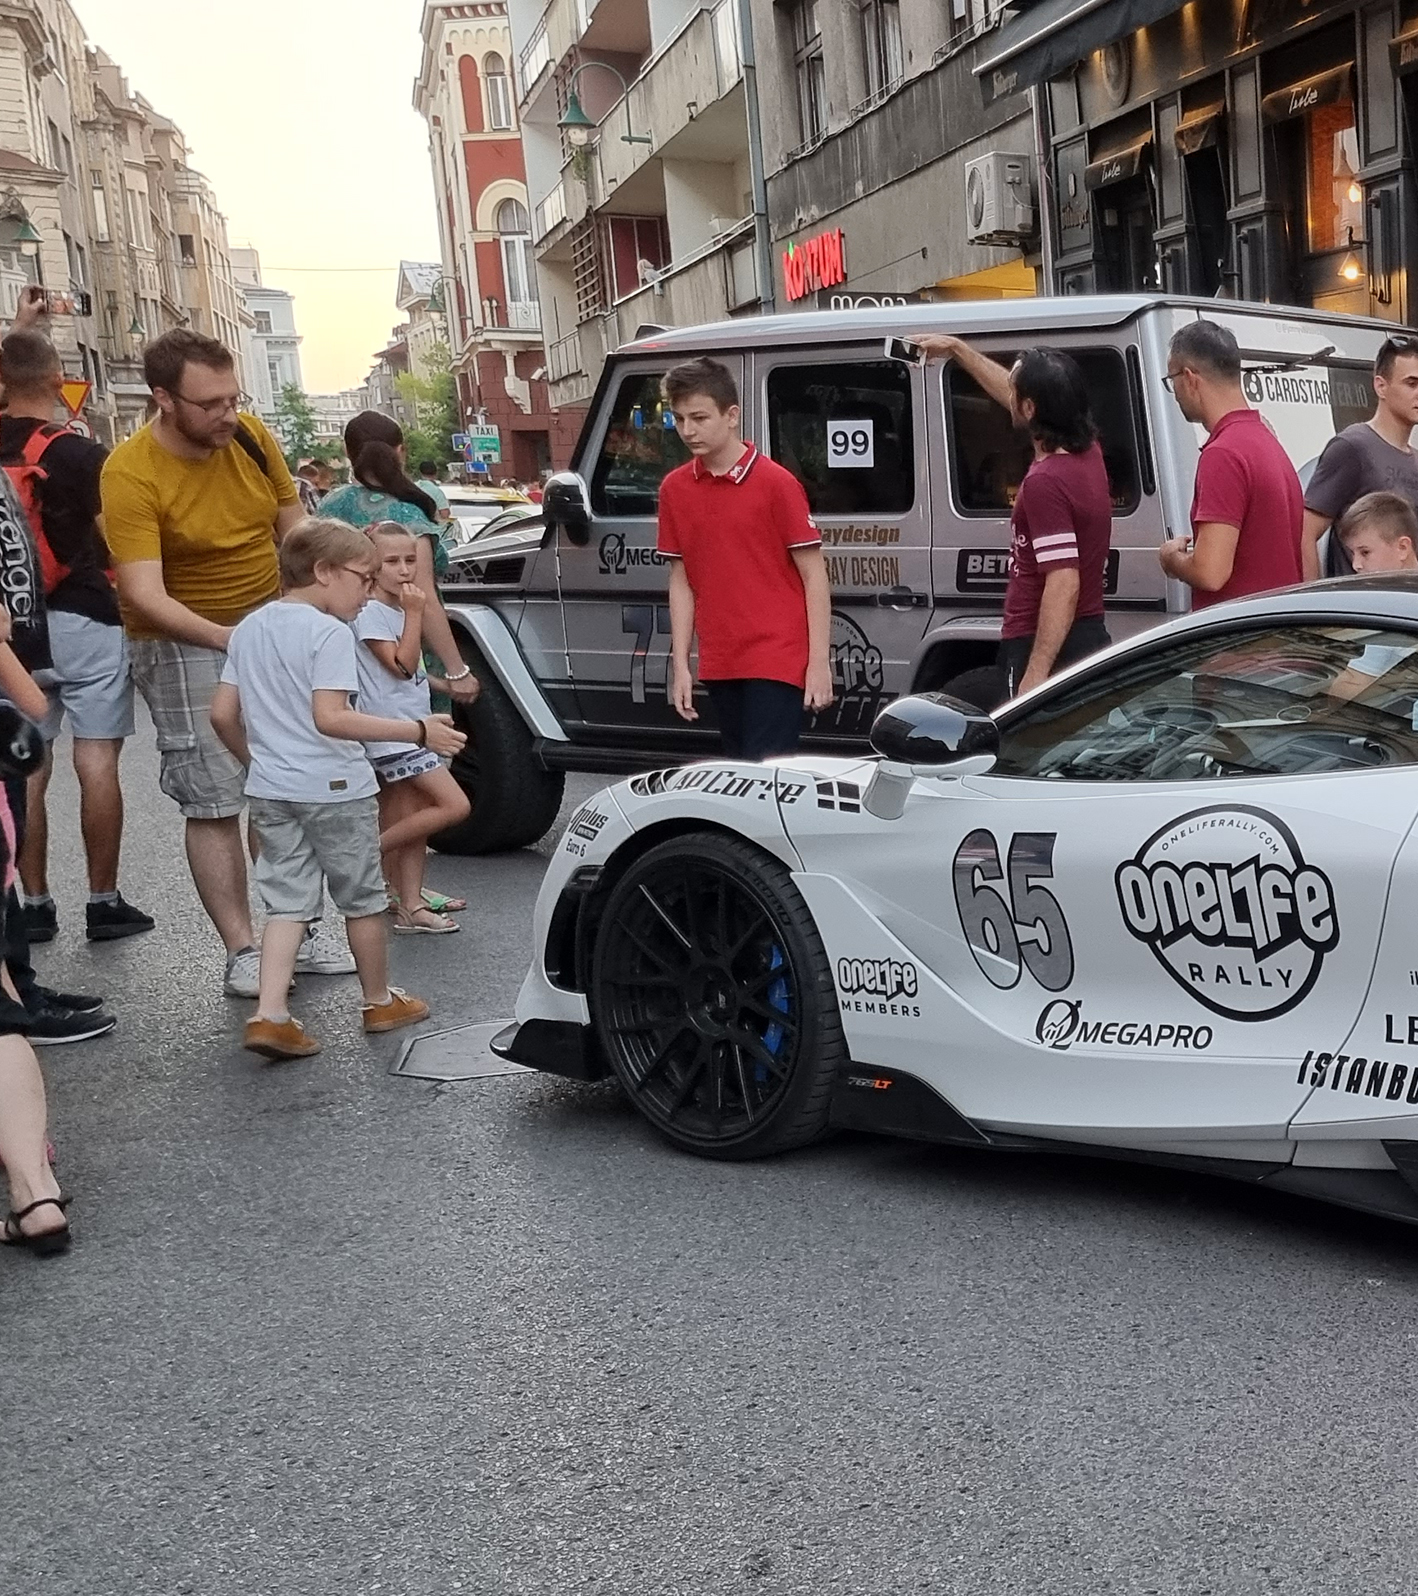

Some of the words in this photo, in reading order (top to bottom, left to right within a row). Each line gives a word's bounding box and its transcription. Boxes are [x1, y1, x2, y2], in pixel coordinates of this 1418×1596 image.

[782, 227, 844, 302] KONZUM
[475, 426, 494, 436] TAXI
[829, 430, 870, 457] 99
[852, 556, 900, 587] DESIGN
[1160, 817, 1281, 855] ONELIFERALLY.COM
[579, 845, 587, 858] 6
[951, 827, 1076, 992] 65
[1188, 963, 1293, 989] RALLY
[841, 999, 922, 1018] MEMBERS
